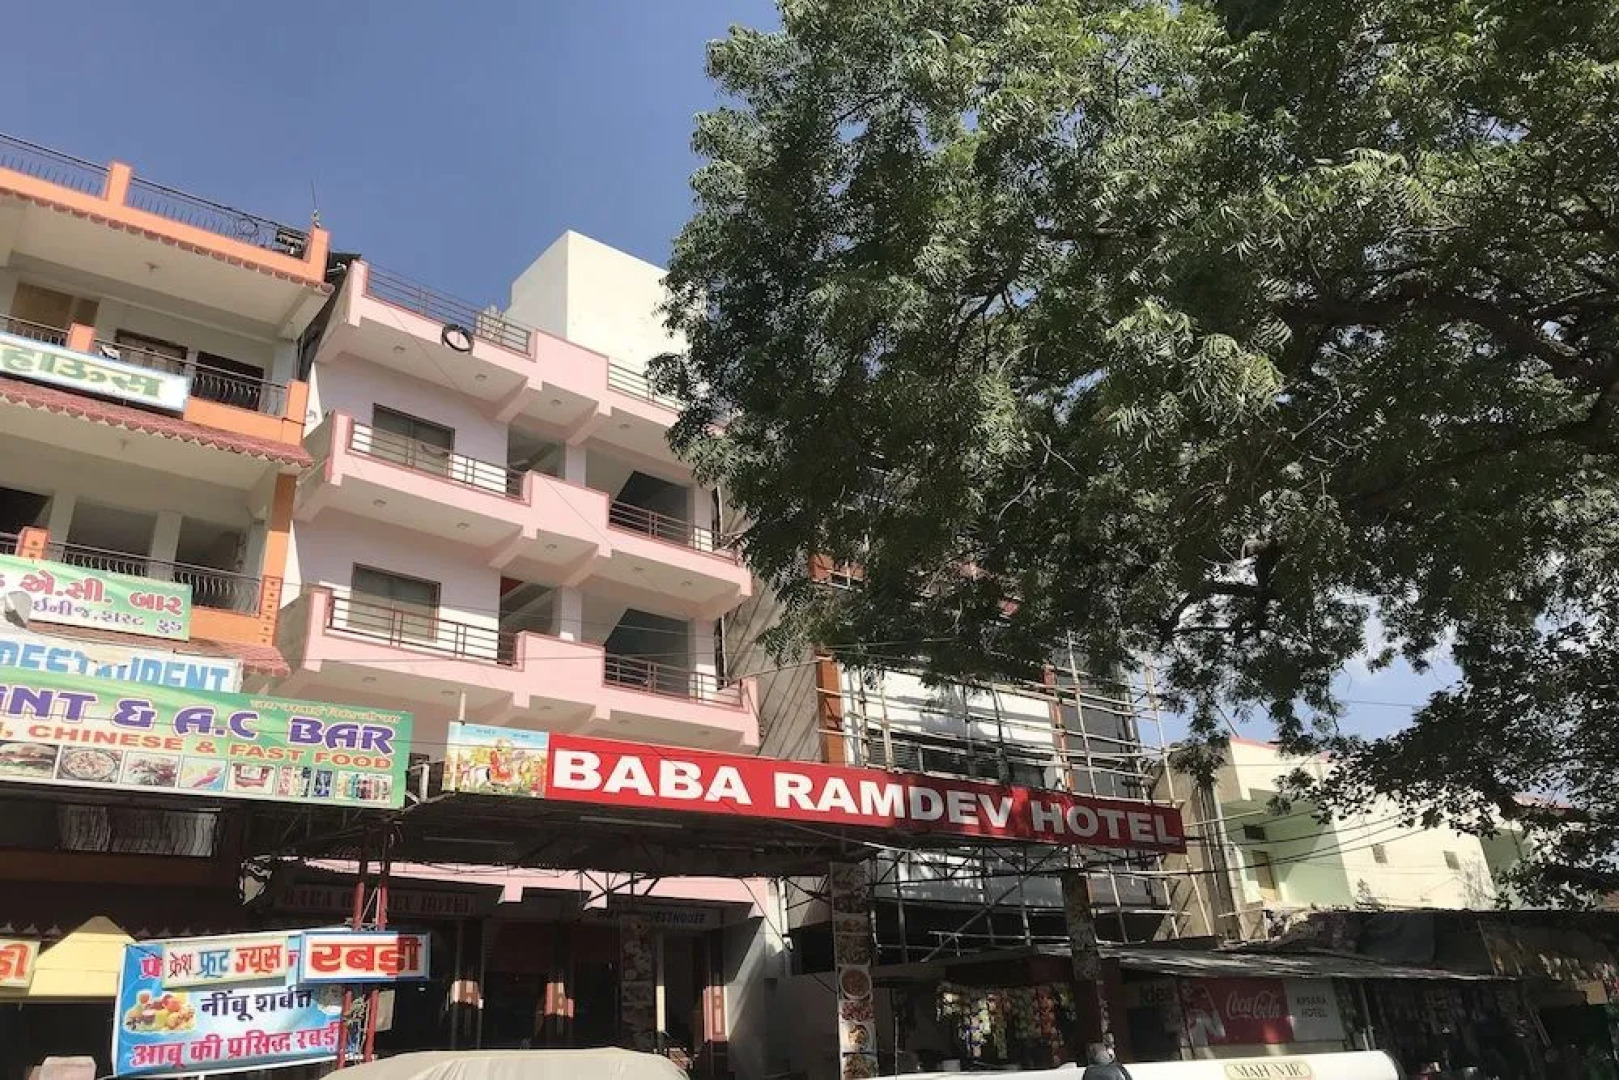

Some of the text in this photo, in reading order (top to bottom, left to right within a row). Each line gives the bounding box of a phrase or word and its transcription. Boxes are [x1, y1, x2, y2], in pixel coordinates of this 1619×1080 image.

[28, 724, 184, 751] CHINESE
[195, 740, 217, 755] &
[229, 743, 303, 763] FAST
[314, 752, 393, 770] FOOD
[113, 698, 156, 730] &
[288, 718, 395, 757] BAR
[552, 748, 1181, 845] BABA RAMDEV HOTEL
[190, 1033, 225, 1061] की
